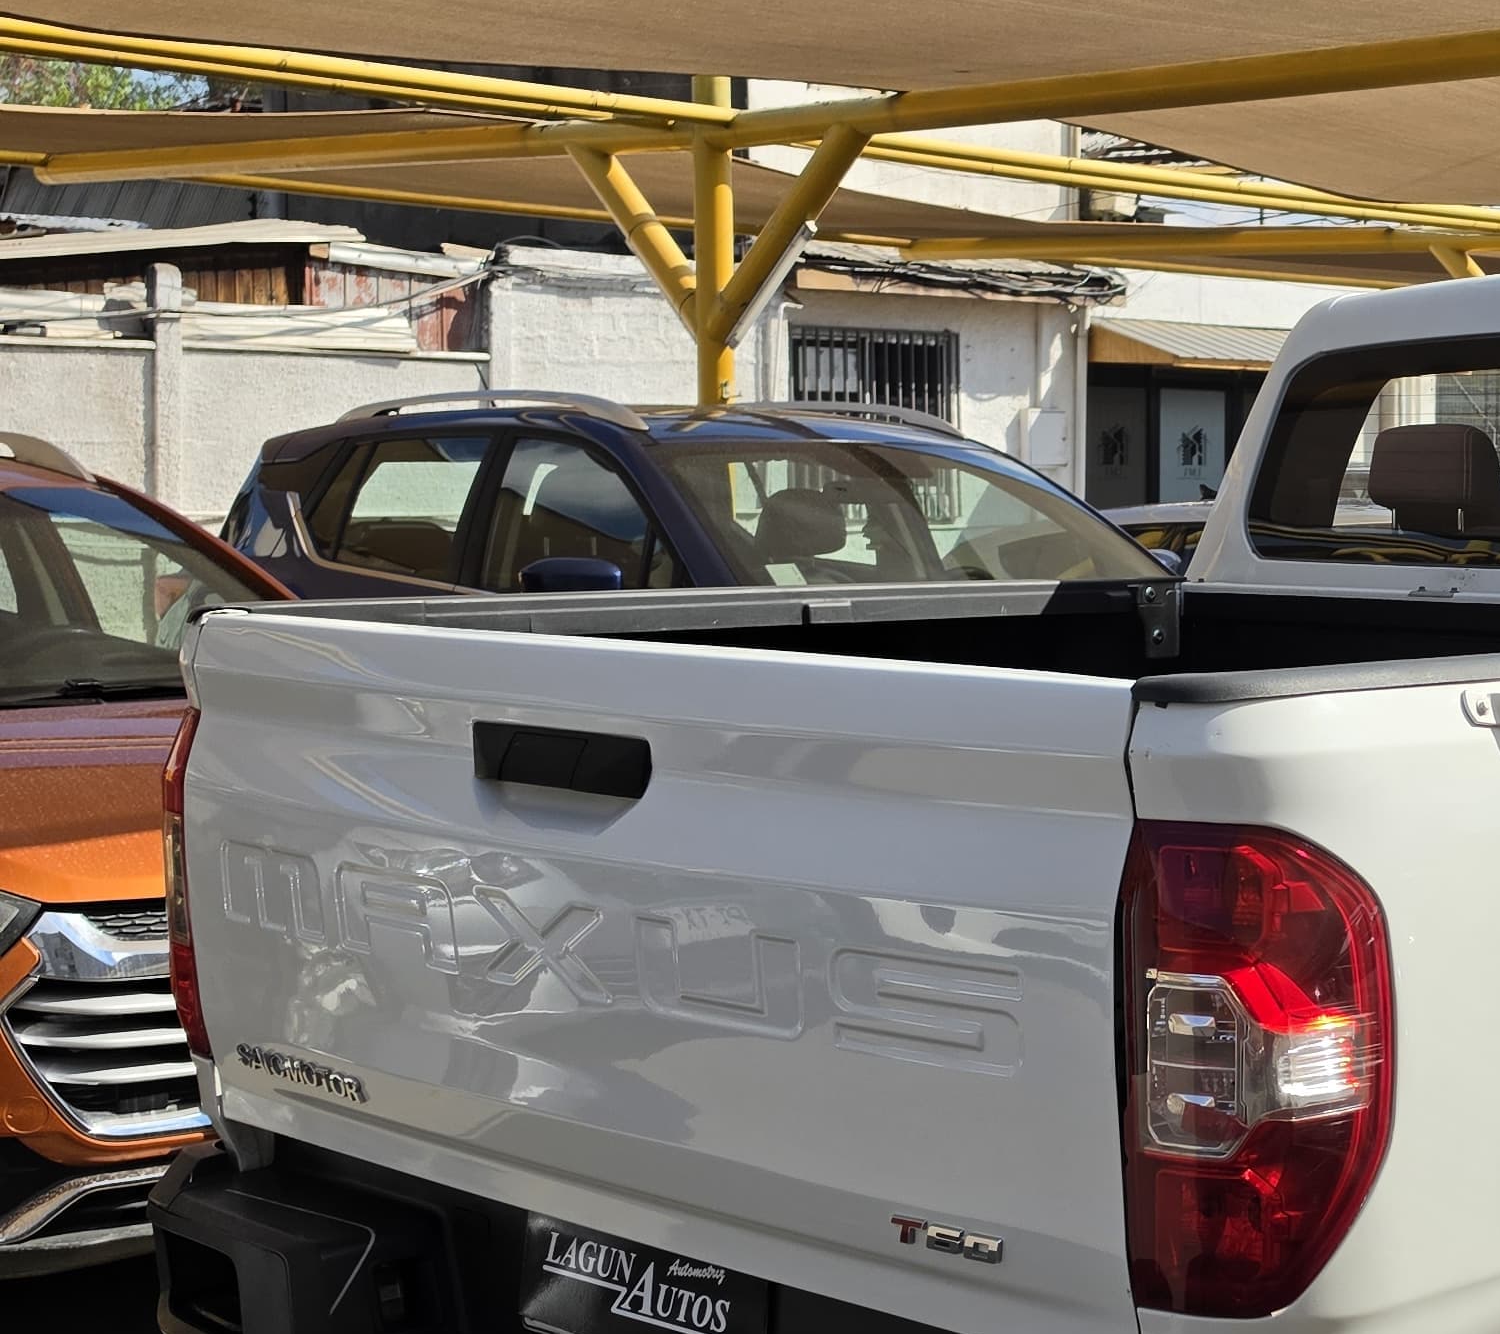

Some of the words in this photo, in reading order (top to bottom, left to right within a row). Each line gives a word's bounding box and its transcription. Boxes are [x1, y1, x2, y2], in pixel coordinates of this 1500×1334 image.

[218, 839, 1024, 1077] MAXUS
[545, 1231, 637, 1284] LAGUN
[620, 1261, 731, 1333] AUTOS
[889, 1213, 1004, 1264] T60
